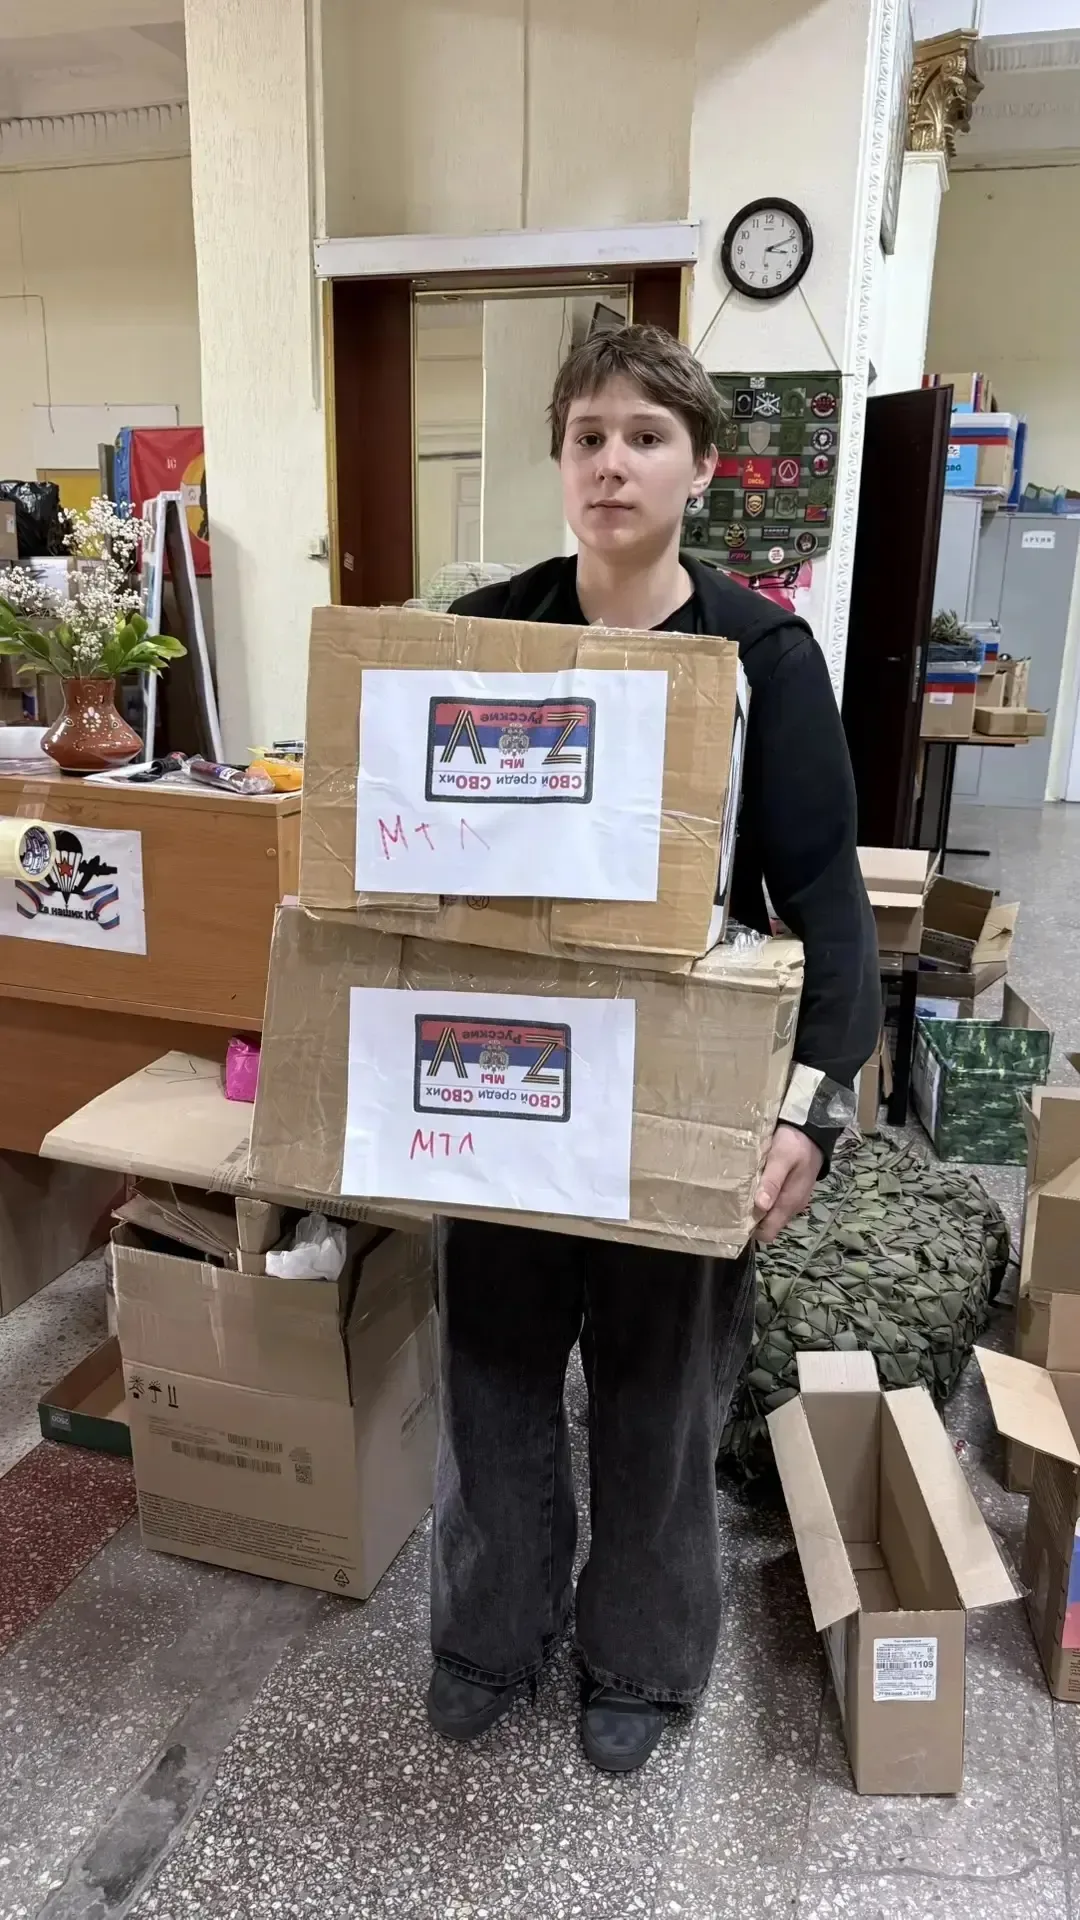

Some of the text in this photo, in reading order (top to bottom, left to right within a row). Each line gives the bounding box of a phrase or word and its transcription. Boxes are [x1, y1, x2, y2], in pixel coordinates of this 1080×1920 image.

[752, 219, 760, 228] 11
[765, 214, 774, 224] 12
[741, 230, 750, 240] 10
[789, 229, 796, 239] 2
[737, 245, 743, 255] 9
[792, 244, 798, 253] 3
[739, 261, 746, 269] 8
[786, 260, 792, 269] 4
[749, 271, 755, 280] 7
[762, 275, 768, 284] 6
[776, 271, 782, 280] 5
[480, 711, 543, 726] Русские
[439, 709, 487, 765] V
[541, 710, 586, 766] Z
[438, 773, 582, 790] СВОй среди СВОих
[51, 907, 84, 919] наших
[462, 1029, 522, 1045] Русские
[426, 1026, 469, 1079] V
[520, 1033, 563, 1085] Z
[425, 1087, 561, 1109] СВОй среди СВОих
[913, 1660, 934, 1669] 1109
